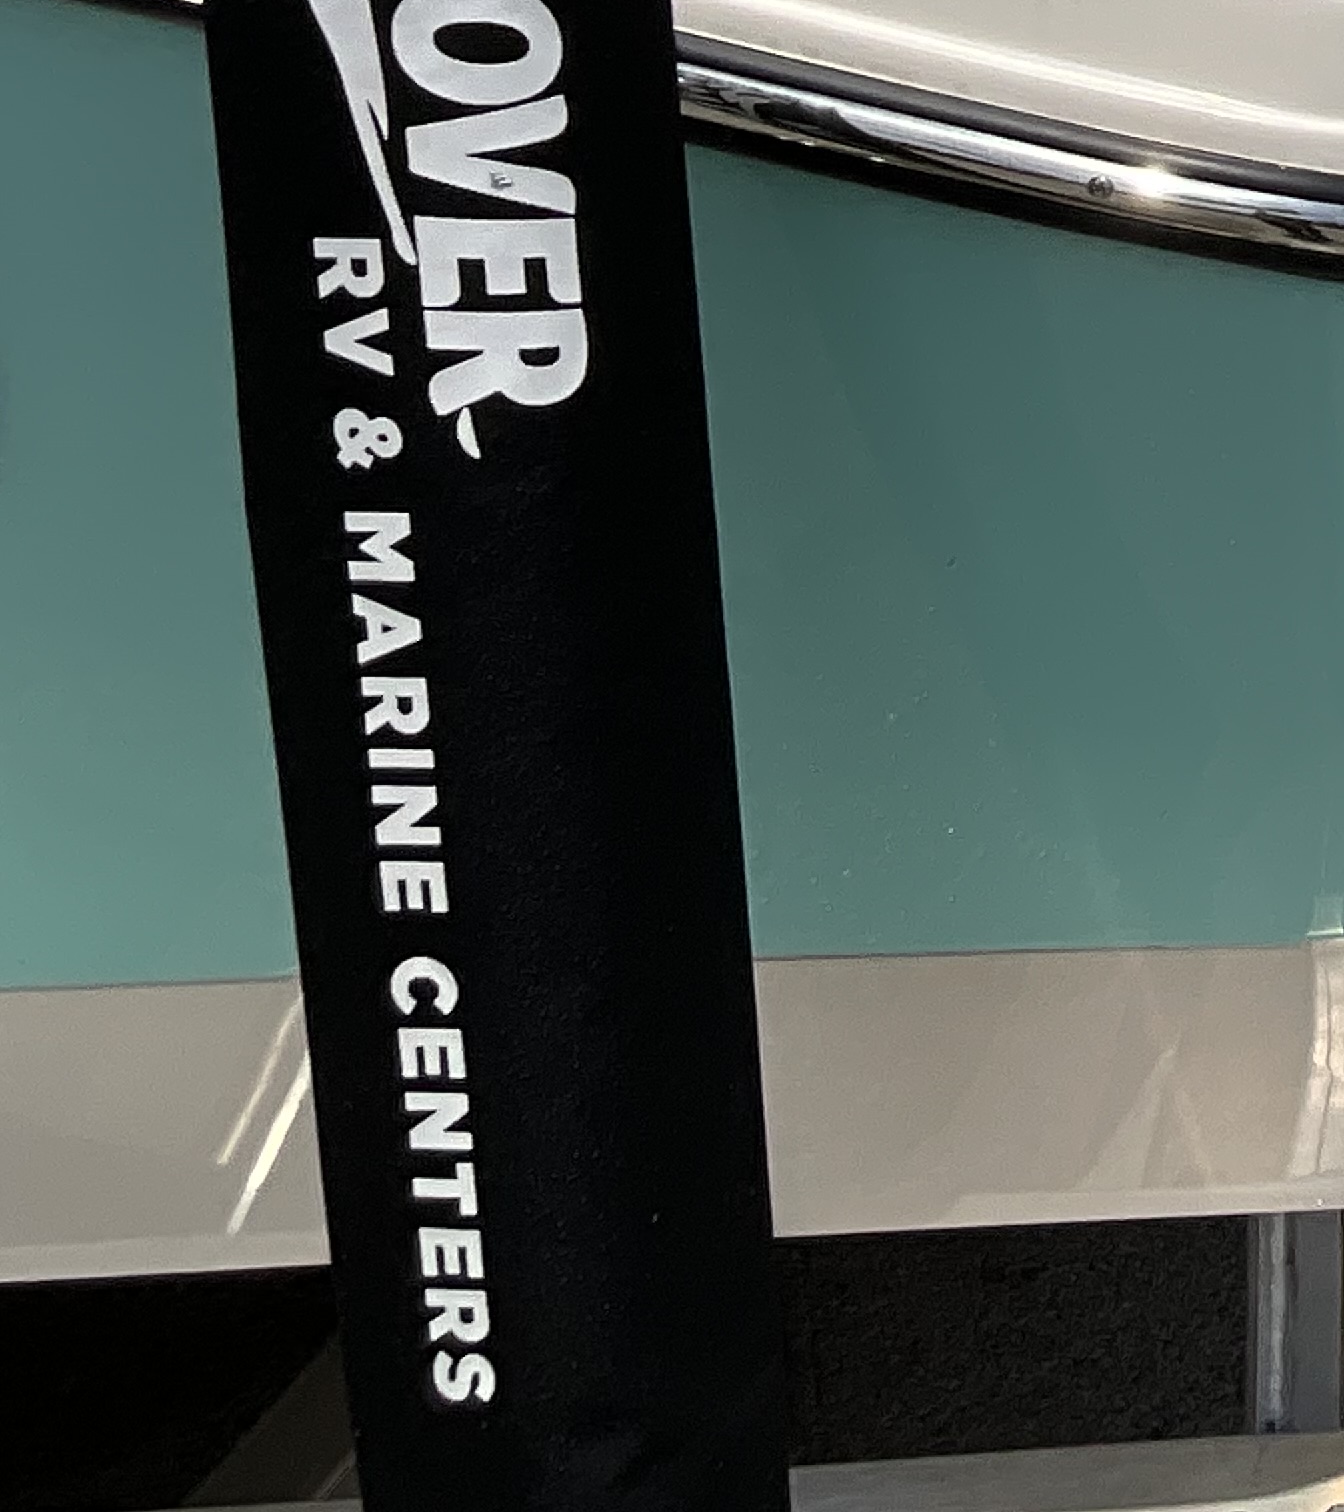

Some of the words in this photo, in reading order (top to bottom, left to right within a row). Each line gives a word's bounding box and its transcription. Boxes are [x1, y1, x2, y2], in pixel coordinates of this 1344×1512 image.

[313, 236, 395, 377] RV
[332, 408, 404, 470] &
[343, 510, 450, 914] MARINE
[390, 956, 496, 1403] CENTERS
